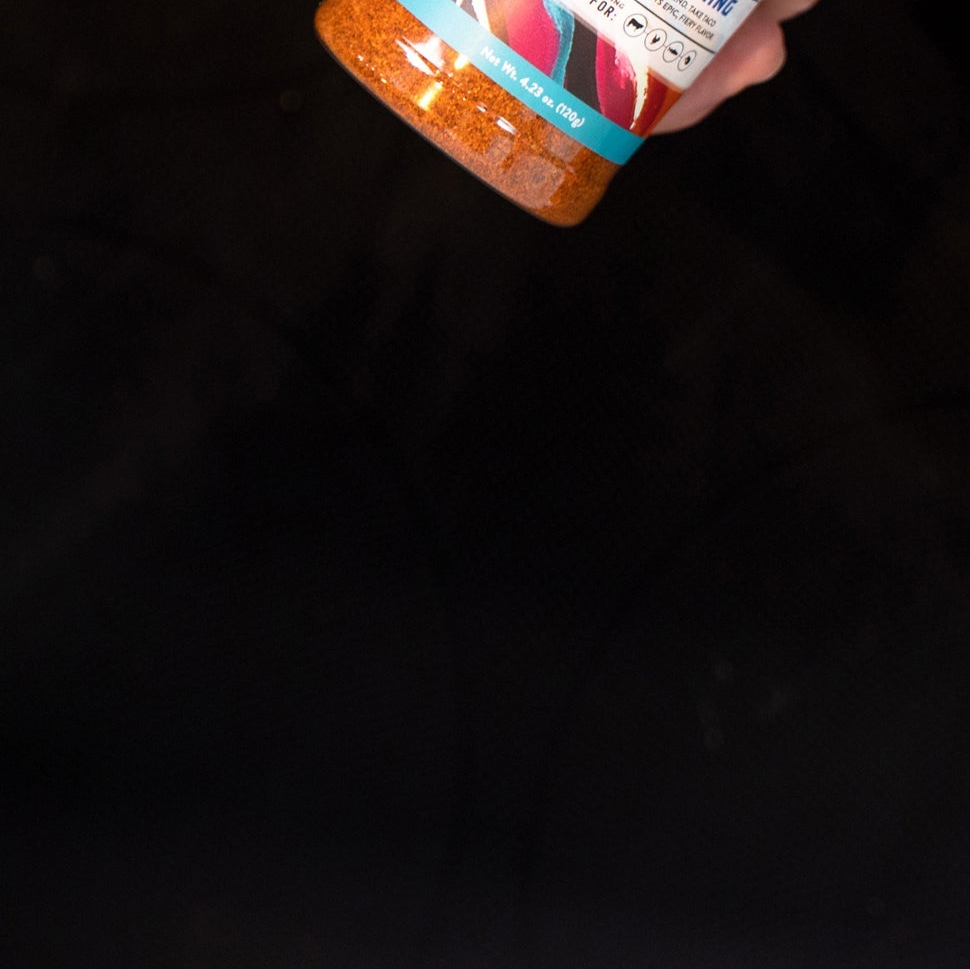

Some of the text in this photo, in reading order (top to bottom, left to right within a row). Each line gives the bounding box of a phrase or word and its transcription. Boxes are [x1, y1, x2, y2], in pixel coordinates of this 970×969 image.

[662, 2, 680, 19] EPIC,
[679, 14, 699, 29] FIERY
[689, 5, 704, 20] TAKE
[702, 15, 717, 27] TACO
[480, 46, 585, 128] Net Wt. 4.23 oz. (120g)
